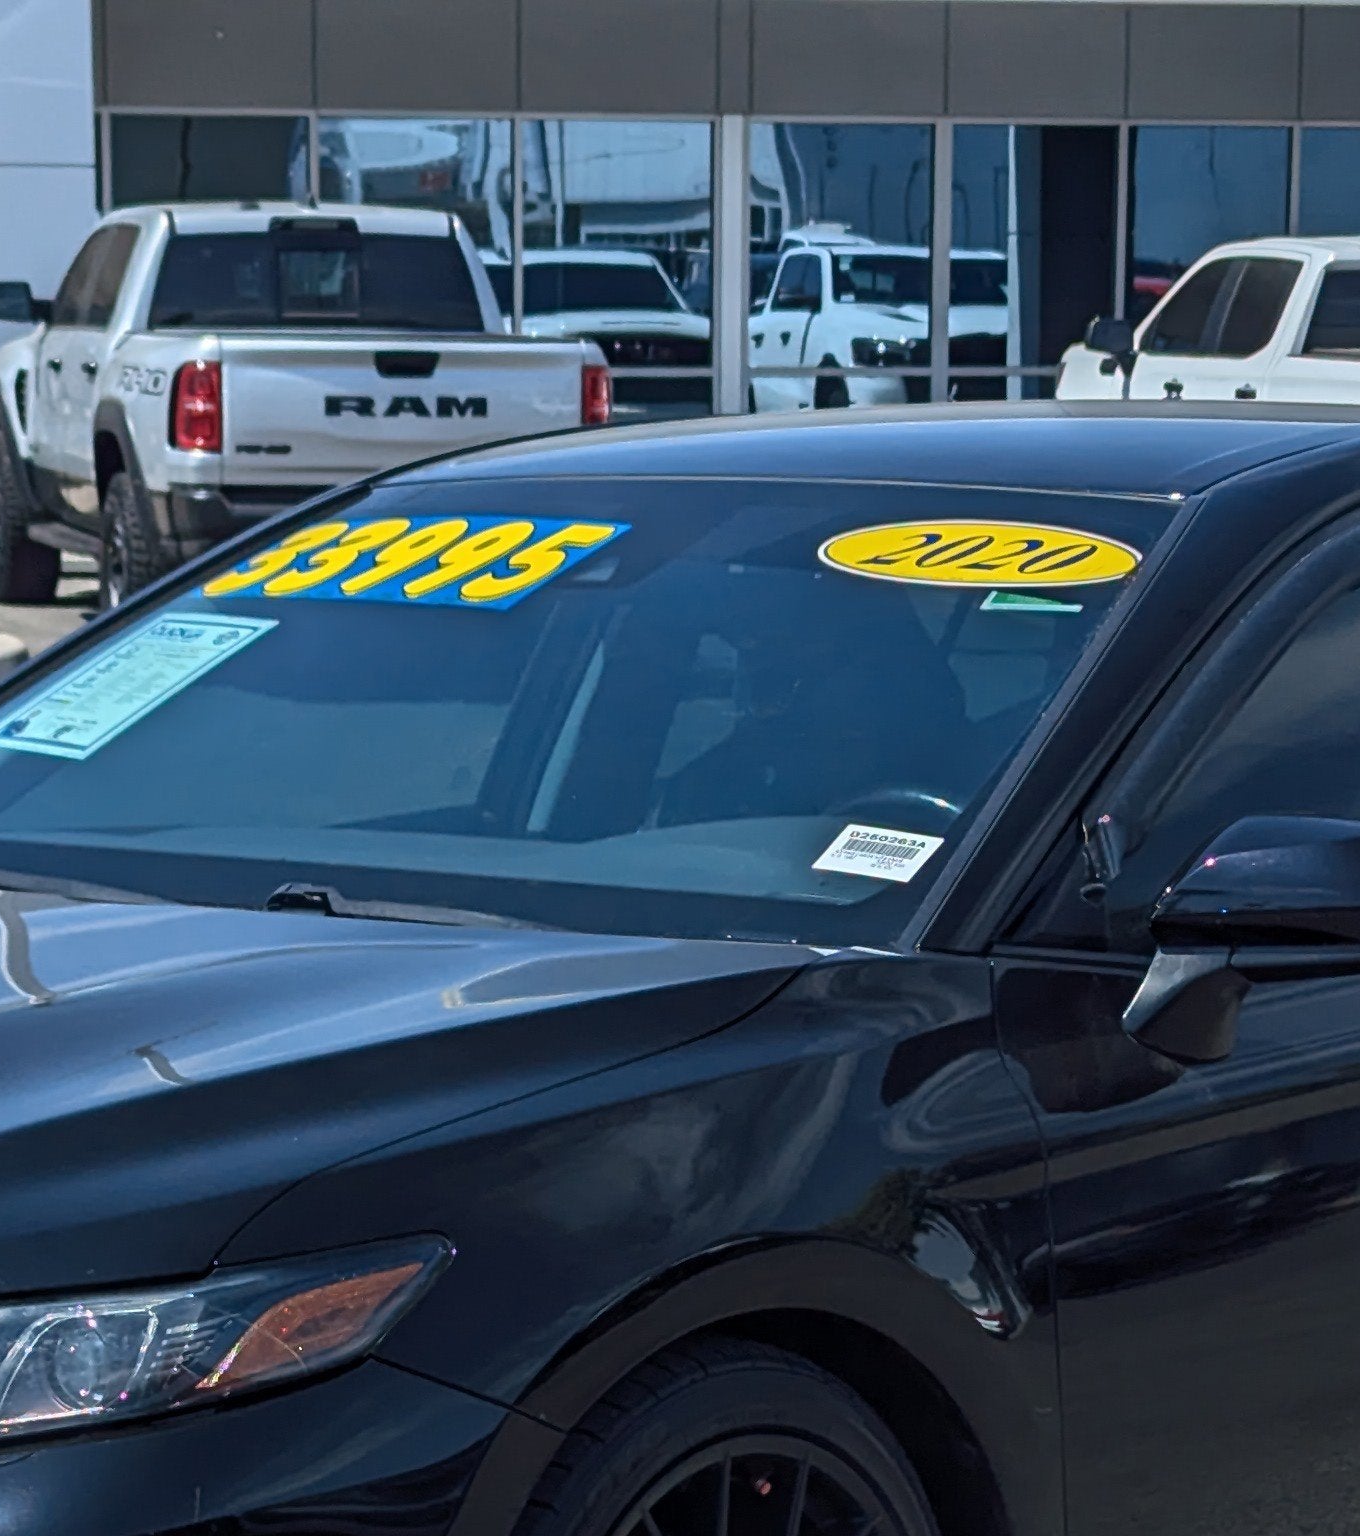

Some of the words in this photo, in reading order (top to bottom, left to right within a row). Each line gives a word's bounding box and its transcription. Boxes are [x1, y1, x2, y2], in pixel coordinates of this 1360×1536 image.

[324, 395, 488, 418] RAM
[203, 518, 616, 603] 33995
[855, 533, 1099, 574] 2020
